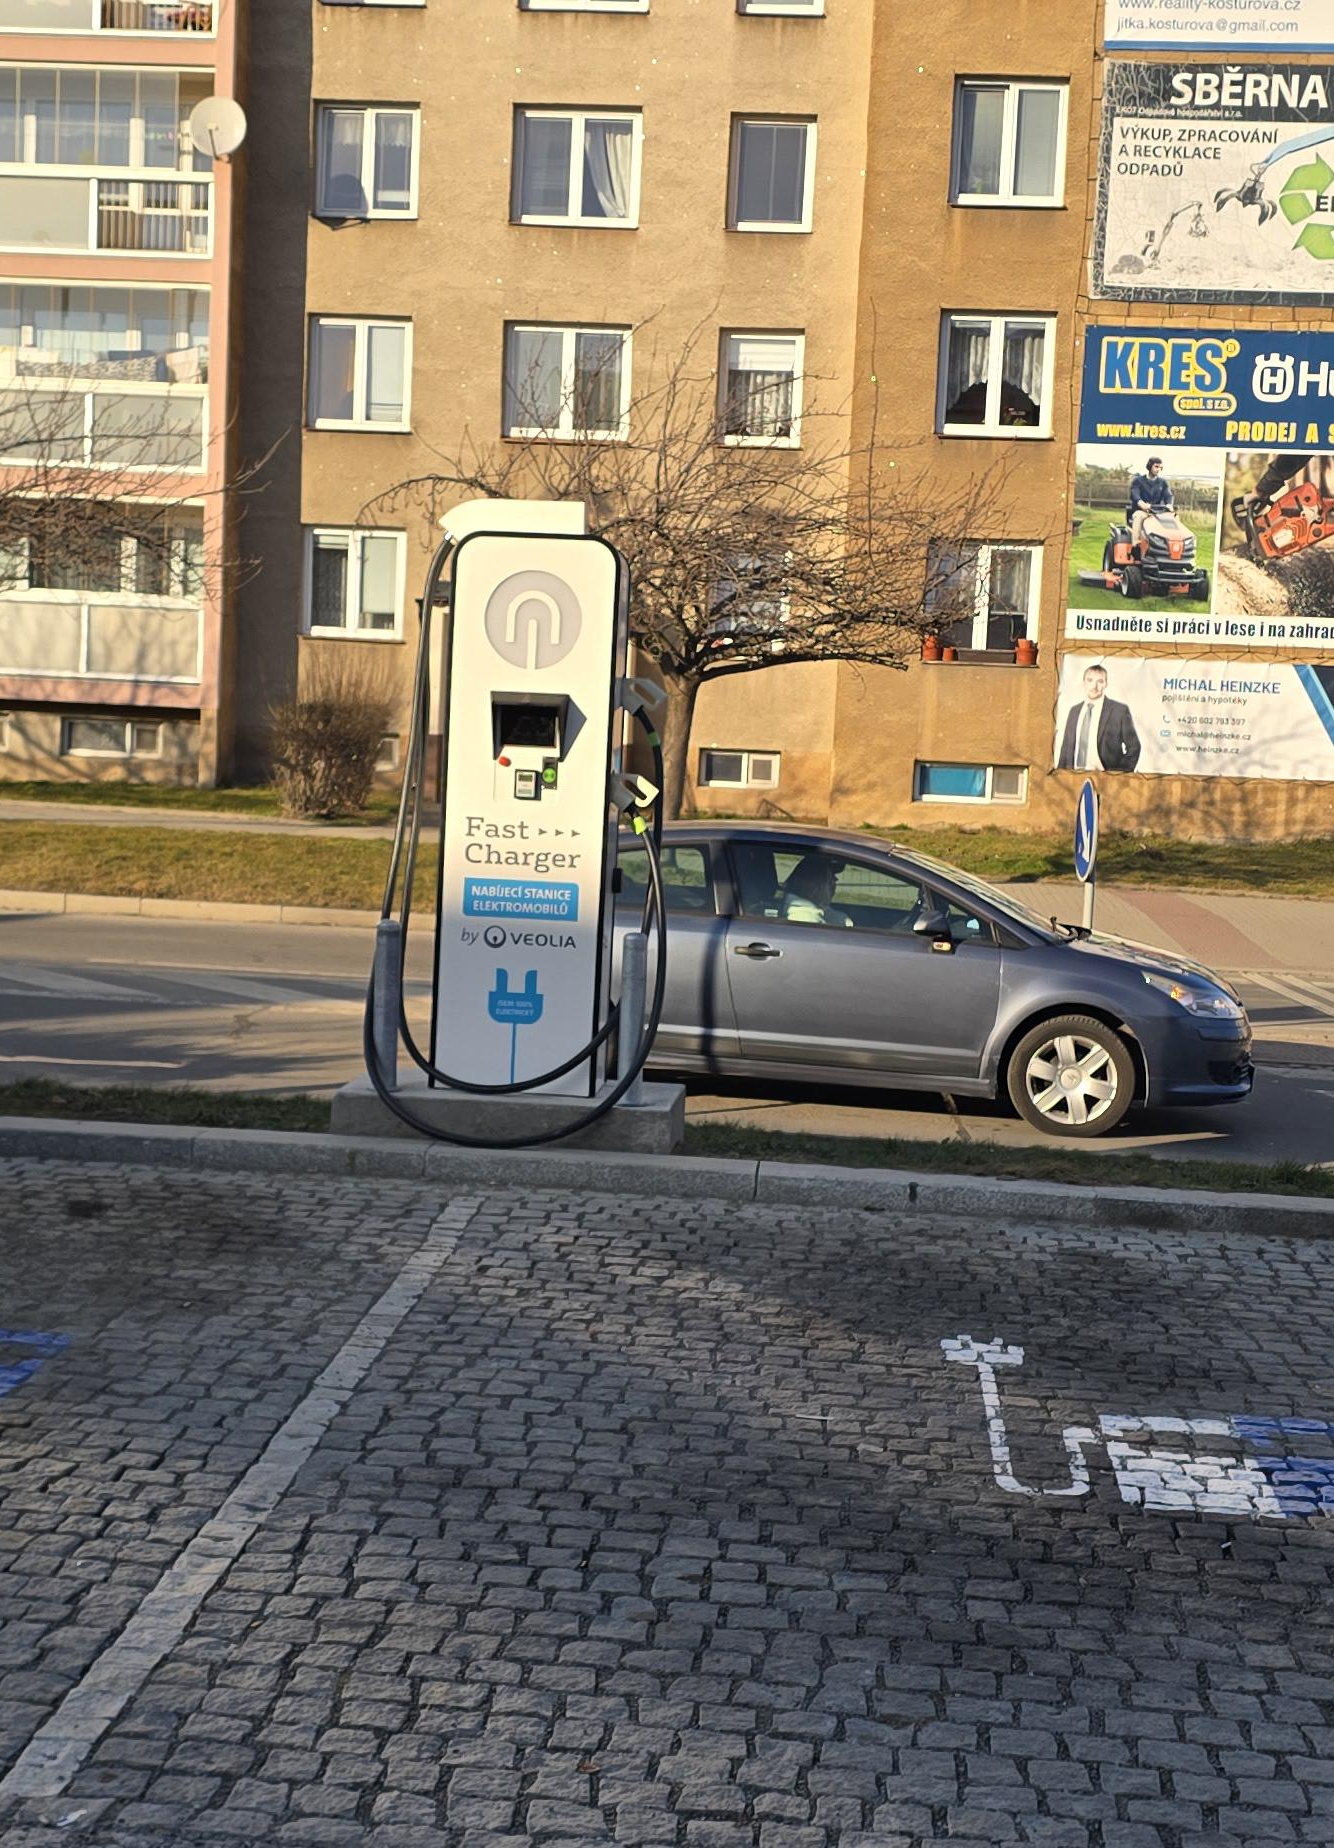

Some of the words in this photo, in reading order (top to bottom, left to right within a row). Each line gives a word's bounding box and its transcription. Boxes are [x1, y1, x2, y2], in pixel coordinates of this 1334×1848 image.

[1170, 66, 1327, 109] SBĚRNA
[1120, 124, 1173, 142] VÝKUP,
[1177, 128, 1279, 144] ZPRACOVÁNÍ
[1119, 144, 1129, 157] A
[1133, 144, 1221, 160] RECYKLACE
[1117, 161, 1184, 177] ODPADŮ
[1101, 339, 1226, 394] KRES
[1096, 422, 1187, 440] www.kres.cz
[1225, 420, 1297, 443] PRODEJ
[1305, 422, 1319, 444] A
[1076, 614, 1152, 633] Usnadněte
[1156, 617, 1168, 633] si
[1172, 618, 1210, 635] práci
[1214, 622, 1223, 635] v
[1225, 620, 1255, 637] lese
[1268, 624, 1285, 638] na
[1163, 678, 1217, 692] MICHAL
[1220, 680, 1281, 694] HEINZKE
[1207, 695, 1248, 706] hypotéky
[464, 816, 530, 840] Fast
[464, 842, 582, 873] Charger
[471, 885, 522, 898] NABÍJECÍ
[524, 887, 572, 901] STANICE
[472, 900, 569, 915] ELEKTROMOBILŮ
[460, 927, 480, 946] by
[510, 932, 577, 949] VEOLIA
